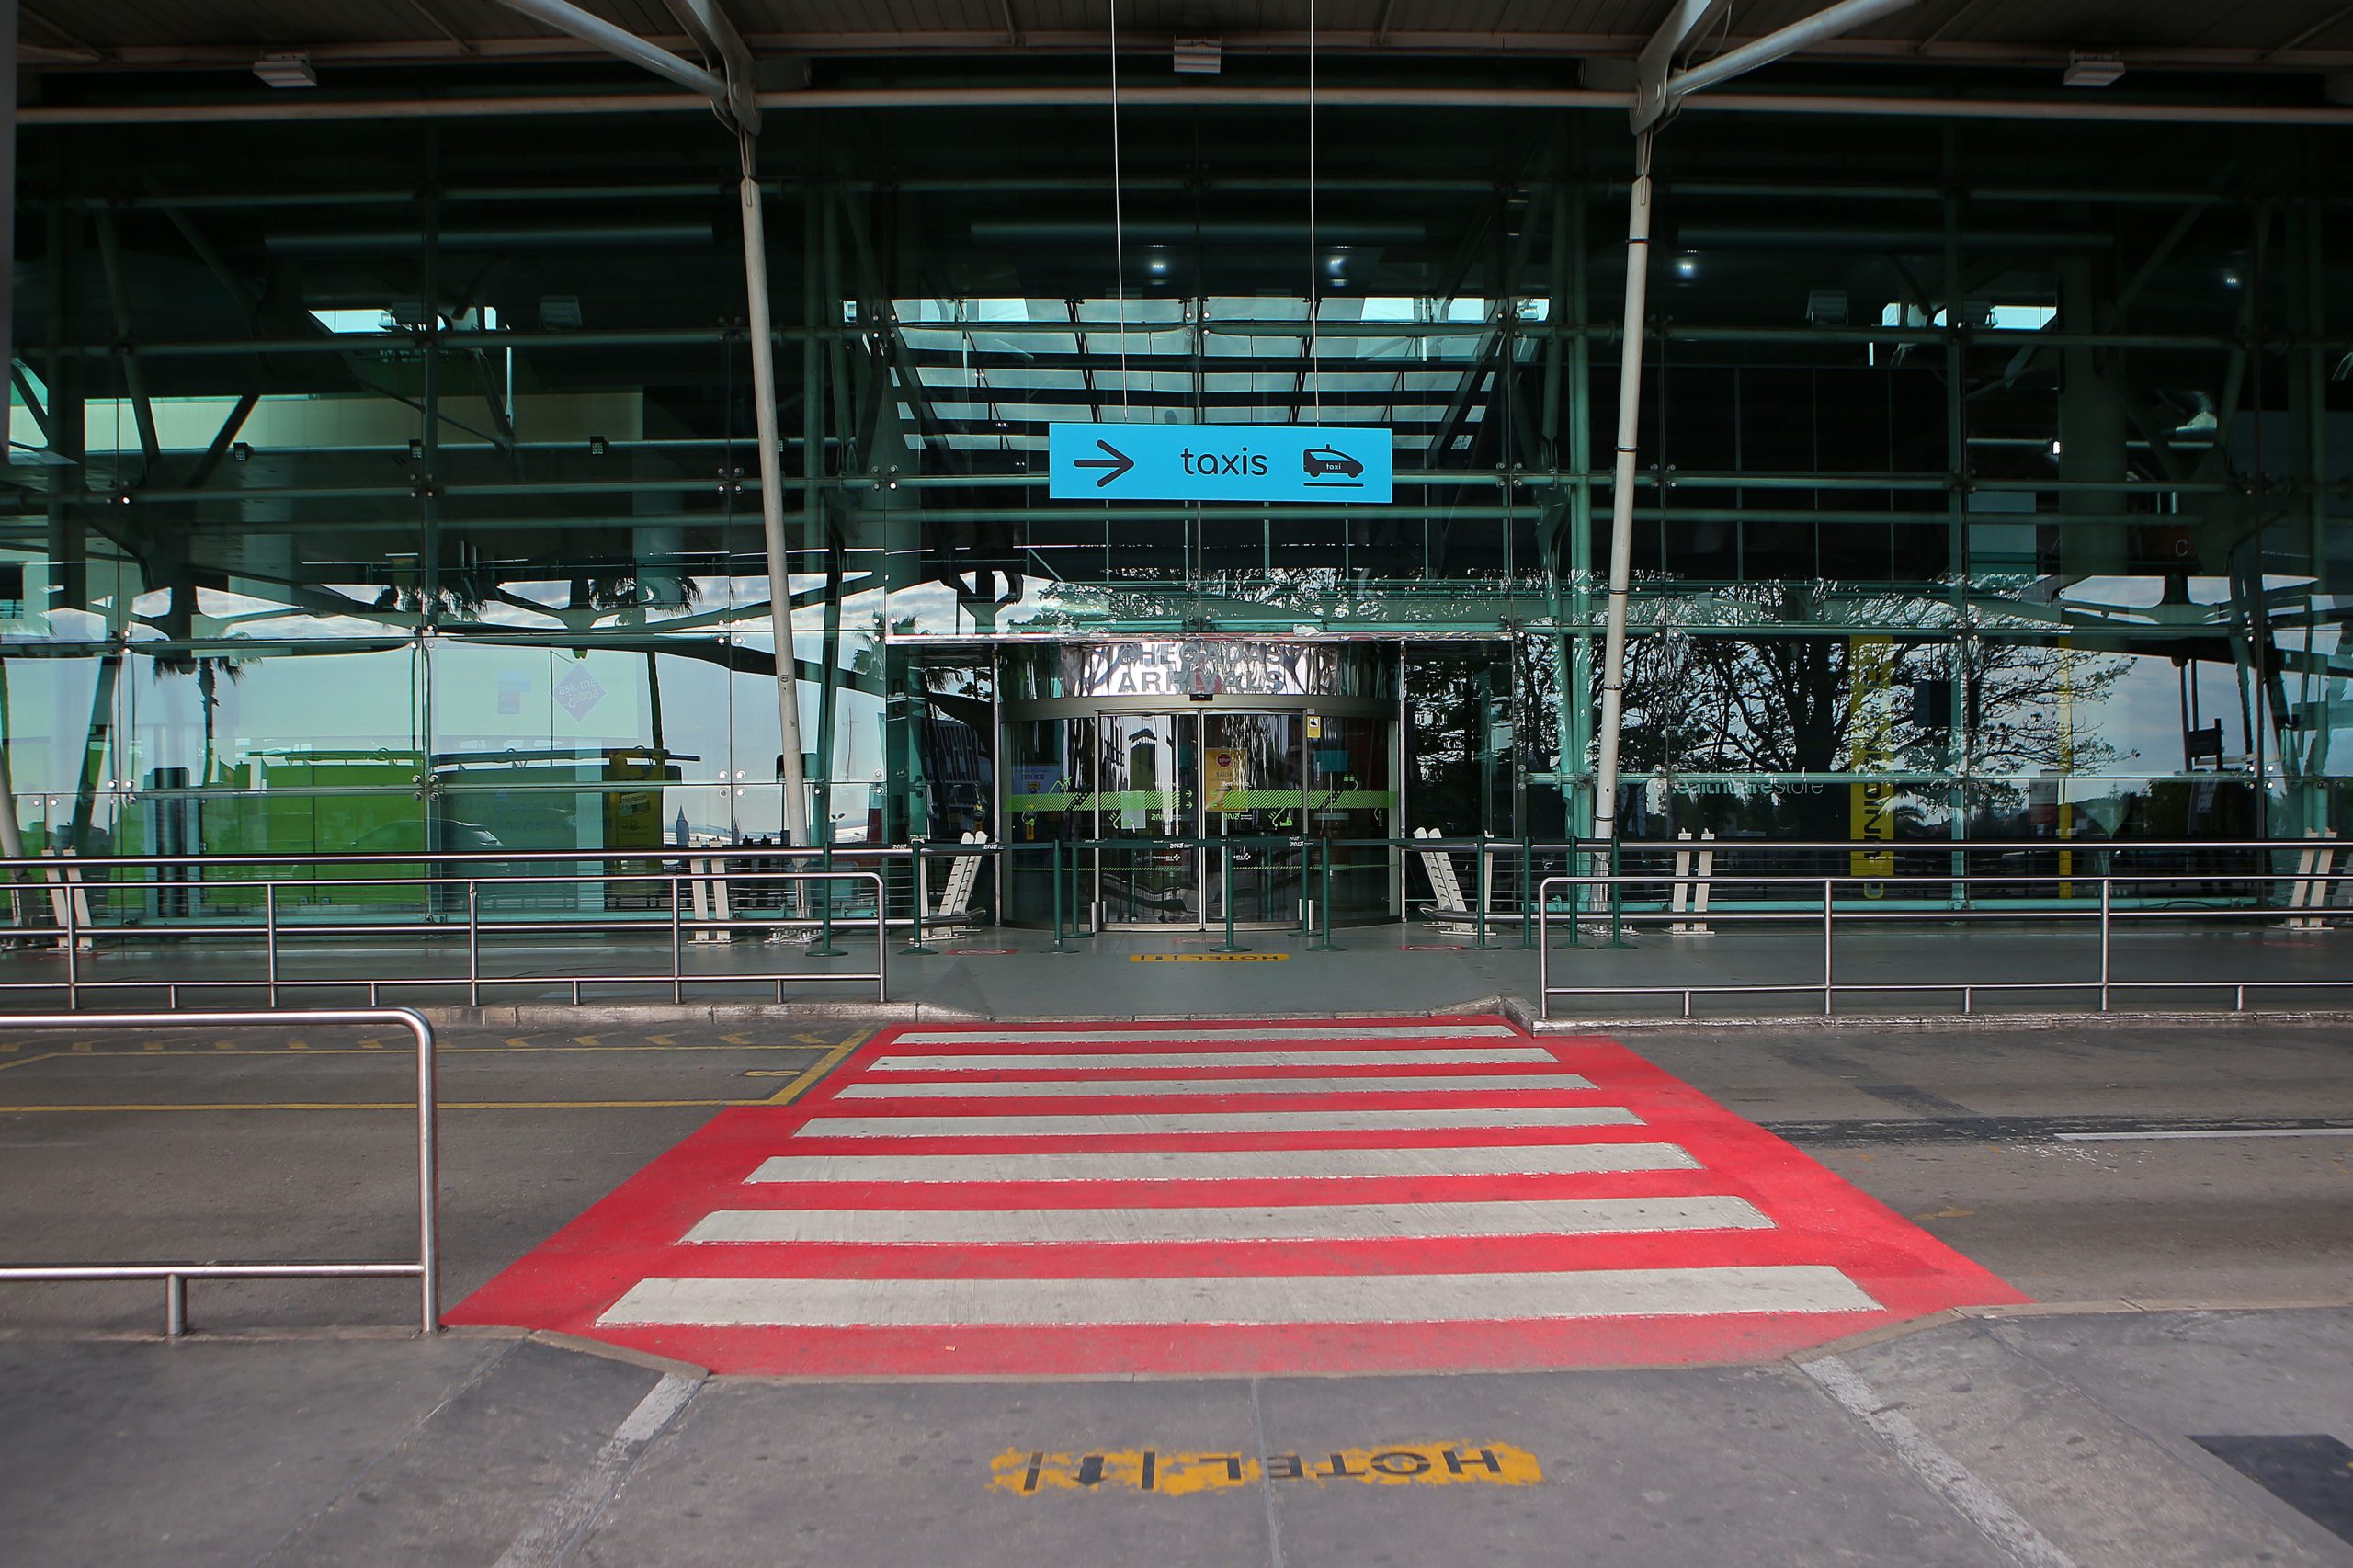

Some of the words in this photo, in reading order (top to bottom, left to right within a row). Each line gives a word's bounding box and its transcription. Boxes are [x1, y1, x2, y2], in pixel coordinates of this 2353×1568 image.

[1180, 447, 1268, 476] taxis
[1118, 643, 1284, 665] CHEGADAS
[559, 682, 577, 695] ask
[580, 677, 597, 688] me
[1118, 671, 1284, 692] ARRIVALS
[1199, 1449, 1503, 1482] HOTEL
